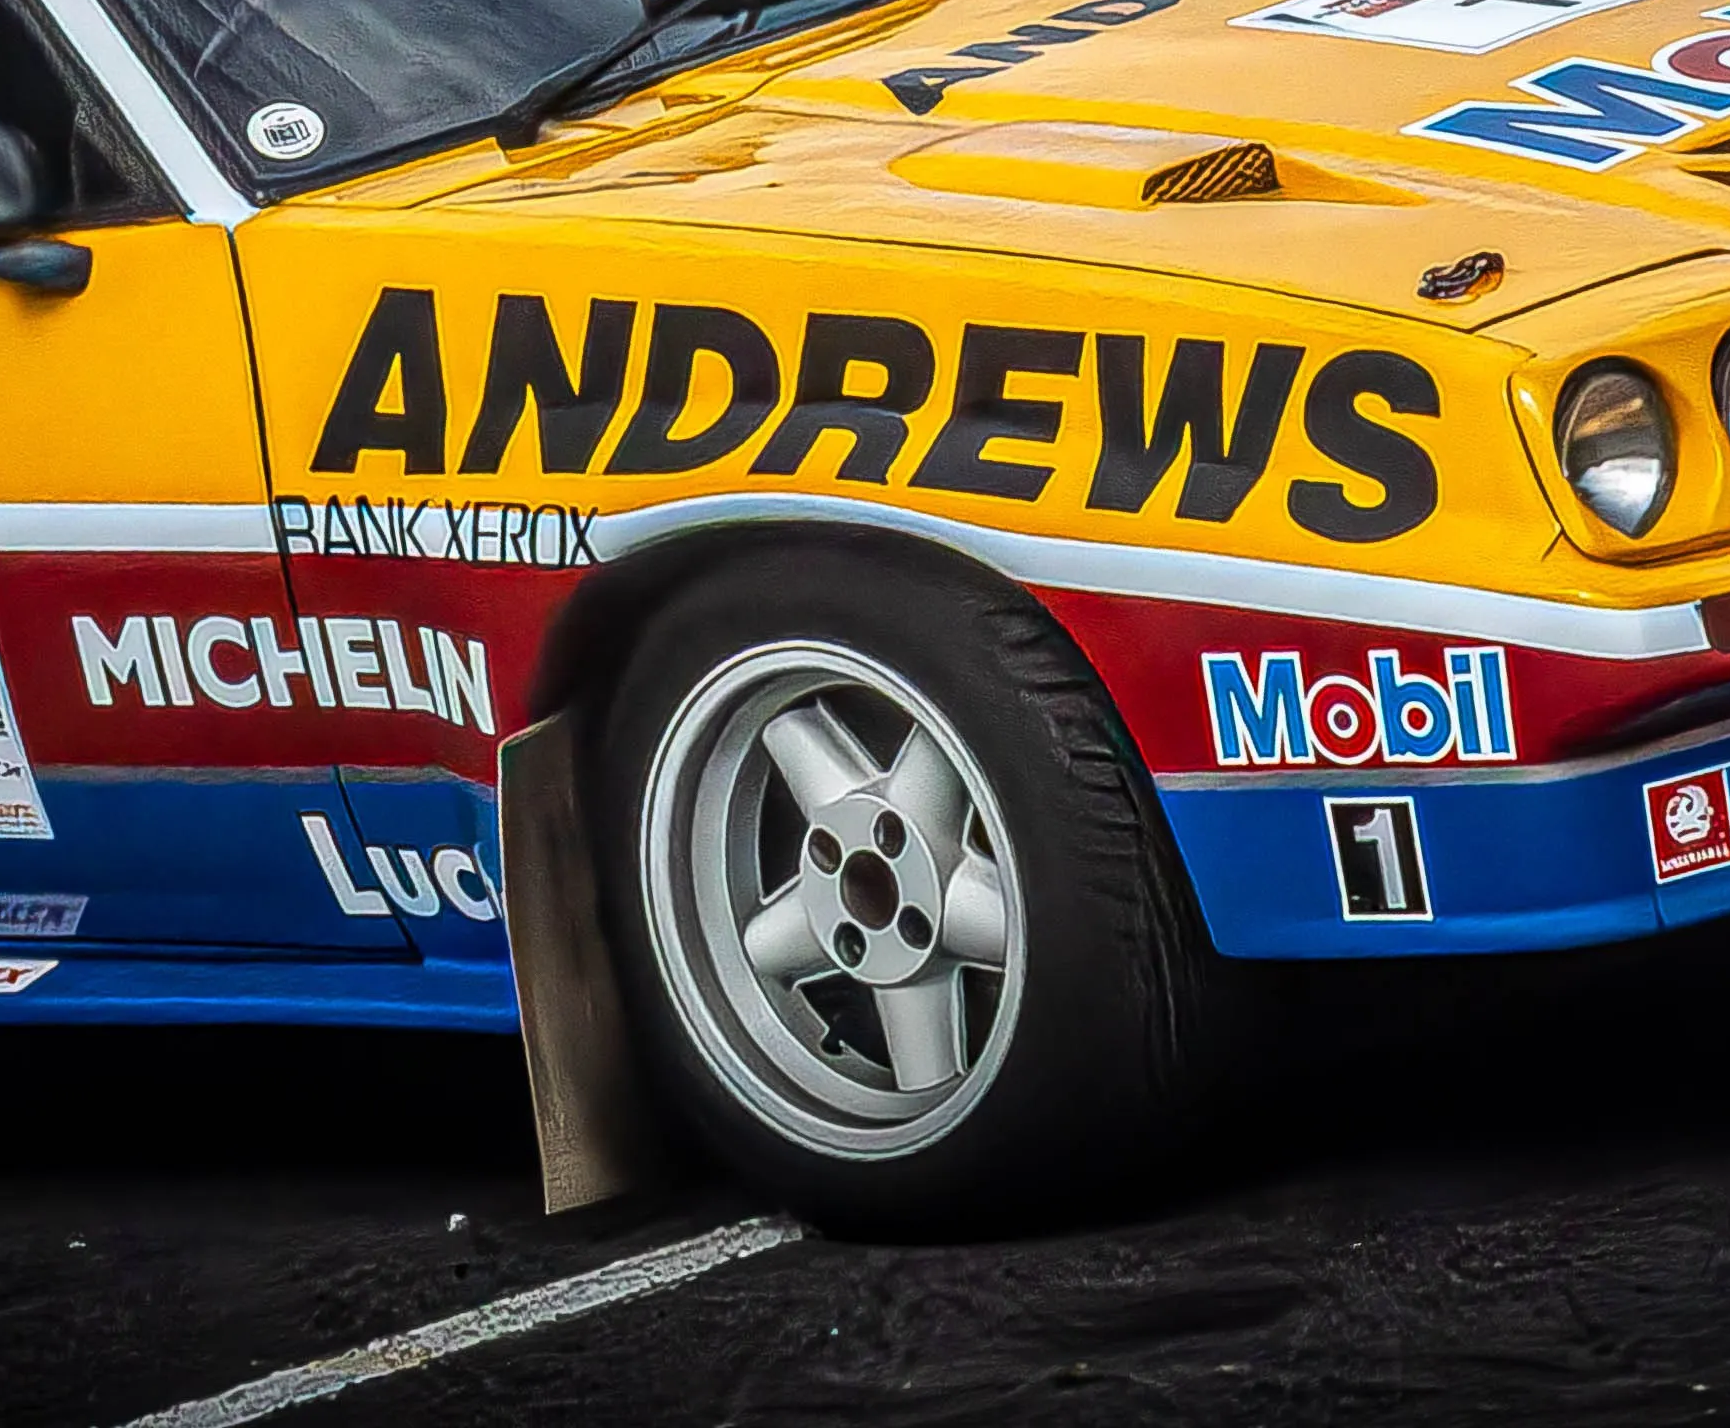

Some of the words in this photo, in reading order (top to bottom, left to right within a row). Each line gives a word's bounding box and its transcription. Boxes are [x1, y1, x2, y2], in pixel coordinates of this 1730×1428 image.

[310, 286, 1439, 544] ANDREWS
[442, 499, 600, 567] XEROX
[71, 616, 495, 735] MICHELIN
[1202, 647, 1517, 766] Mobil
[1353, 808, 1408, 910] 1
